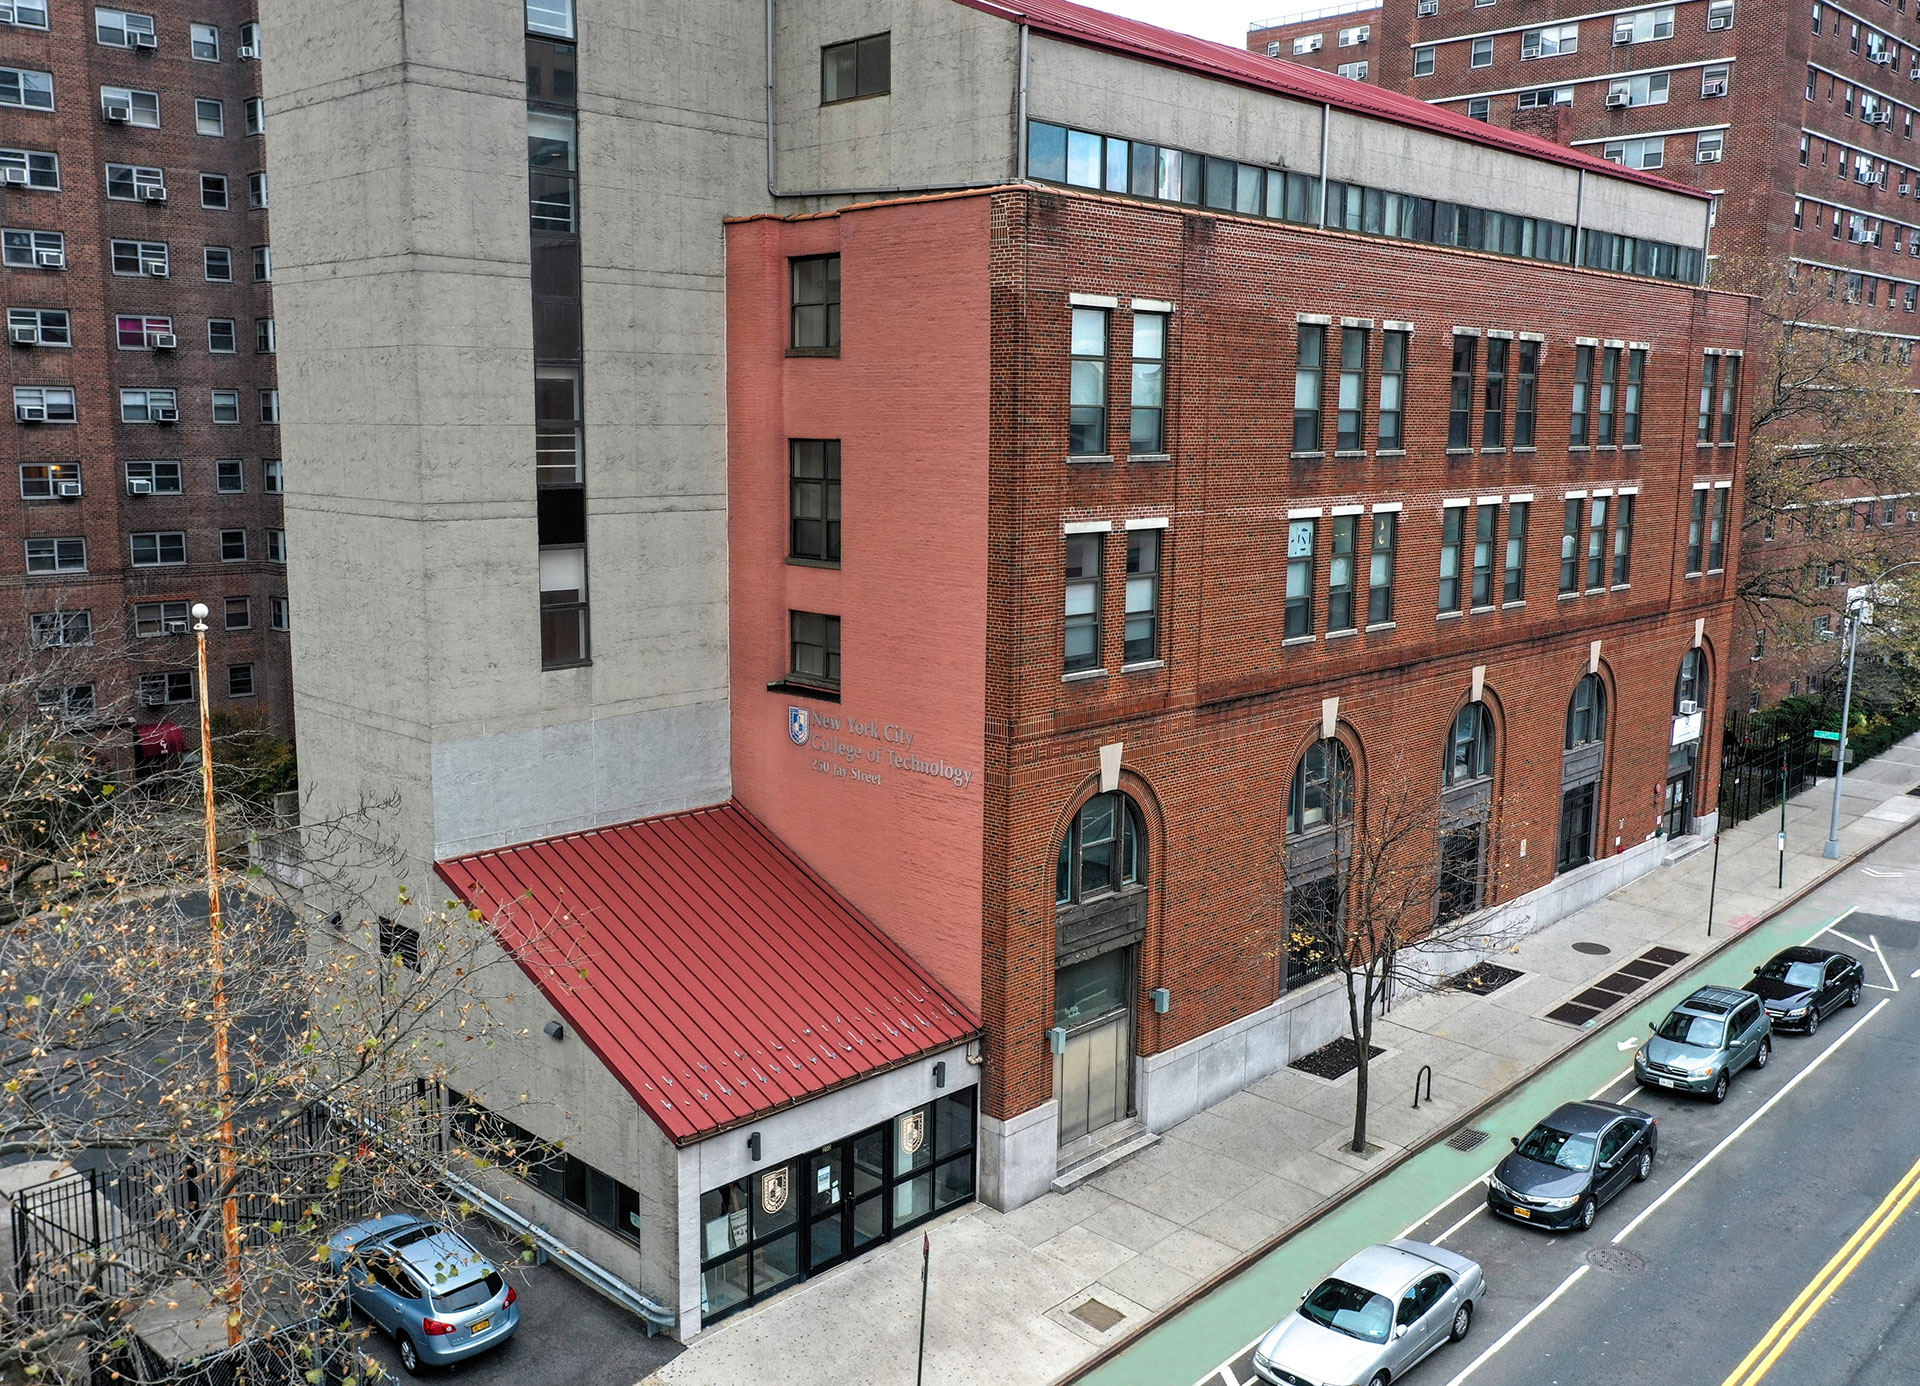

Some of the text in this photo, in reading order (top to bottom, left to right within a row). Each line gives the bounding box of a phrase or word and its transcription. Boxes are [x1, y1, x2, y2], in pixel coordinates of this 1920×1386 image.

[811, 710, 841, 731] New
[847, 717, 880, 740] York
[883, 724, 915, 751] City
[811, 733, 974, 788] College of Technology
[812, 759, 830, 773] 250
[851, 767, 882, 785] Street
